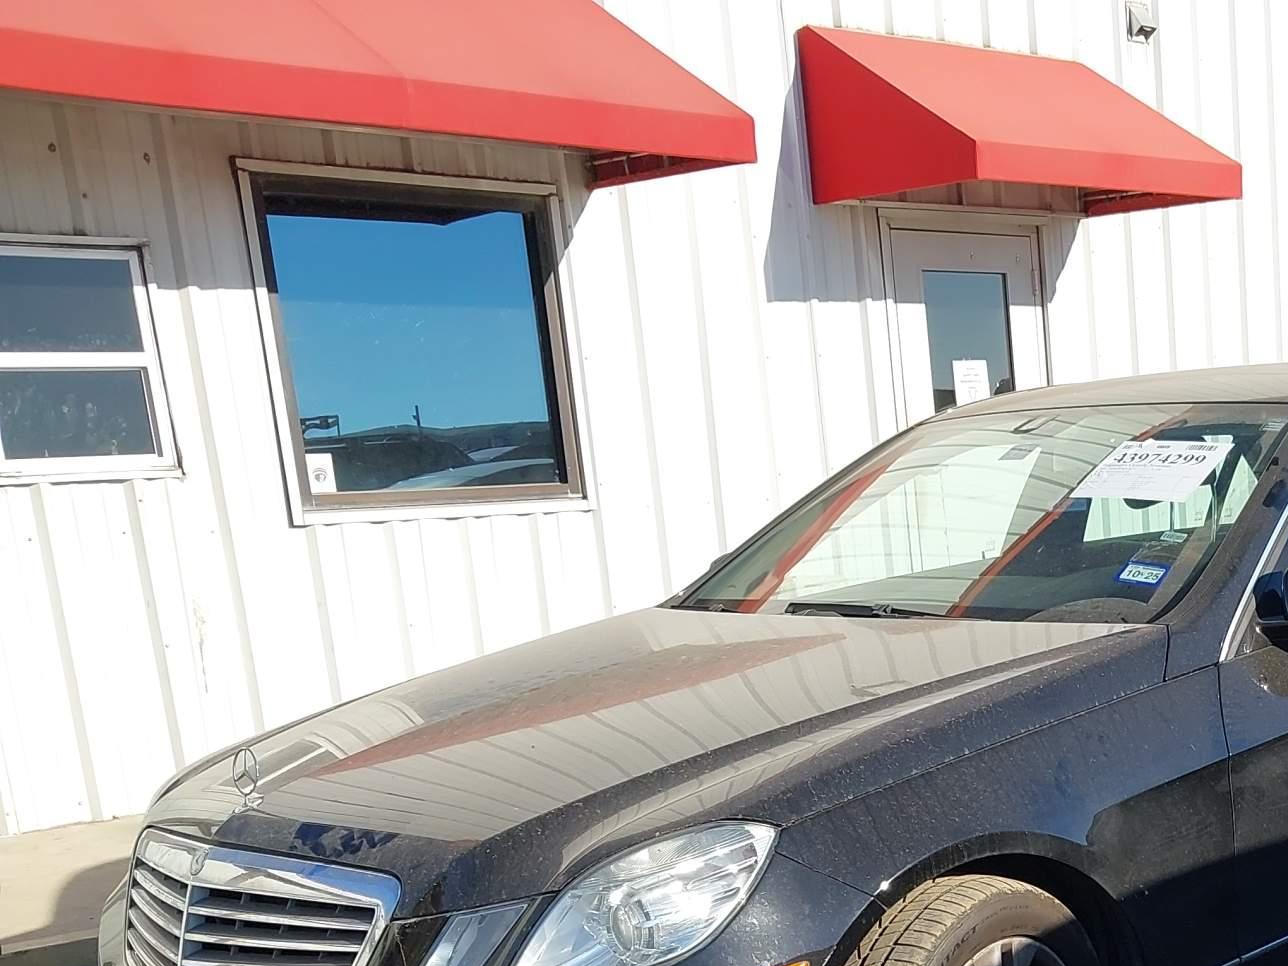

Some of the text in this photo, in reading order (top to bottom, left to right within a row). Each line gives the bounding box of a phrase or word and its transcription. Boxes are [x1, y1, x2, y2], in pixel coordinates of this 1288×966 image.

[1114, 452, 1207, 465] 43974299
[1126, 569, 1162, 581] 10 25
